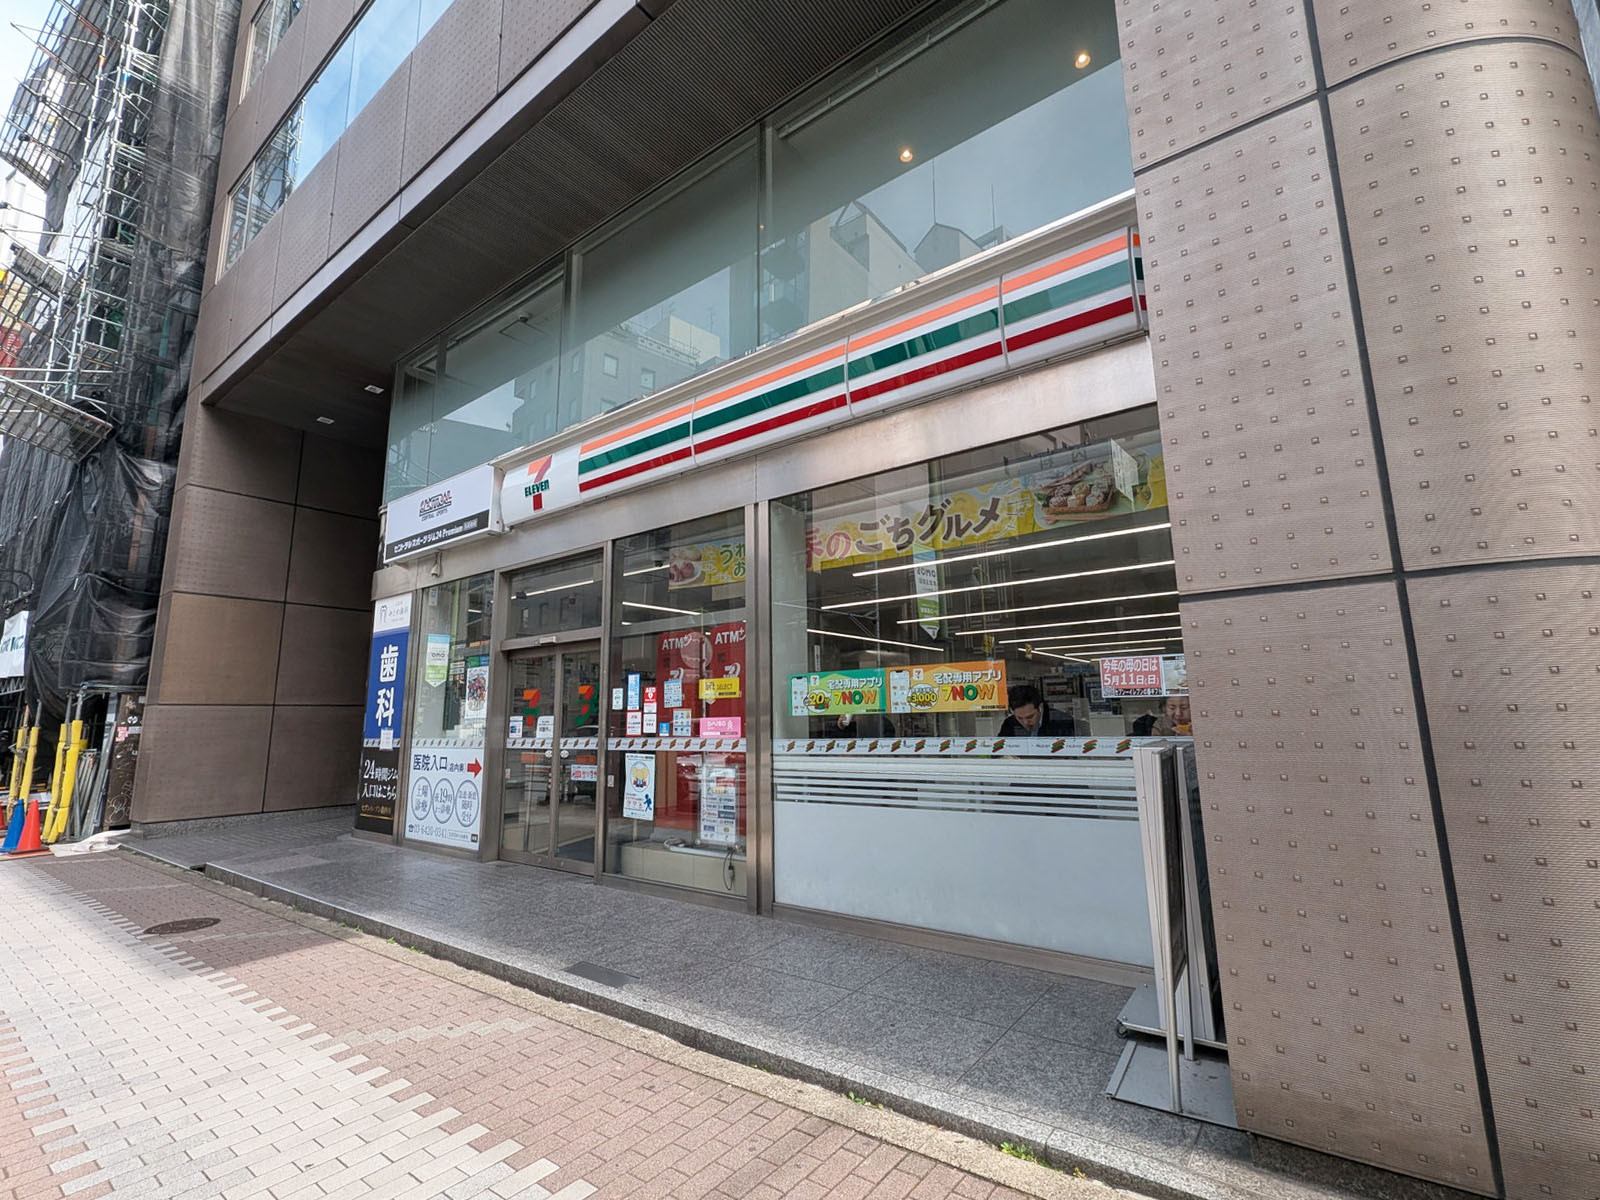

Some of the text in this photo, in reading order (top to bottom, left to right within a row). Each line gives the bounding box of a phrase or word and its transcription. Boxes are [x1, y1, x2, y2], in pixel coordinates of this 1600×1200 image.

[1103, 658, 1158, 673] 今年の母の日は
[827, 676, 883, 690] 宅配専用アプリ
[933, 669, 1002, 684] 宅配専用アプリ
[1103, 673, 1160, 686] 5月11日(日)
[375, 644, 400, 727] 歯科
[941, 684, 995, 701] 7NOW
[832, 690, 877, 705] 7NOW
[363, 759, 399, 782] 24時間ジム
[413, 754, 448, 772] 医院入口
[361, 782, 397, 800] 入口はこちら
